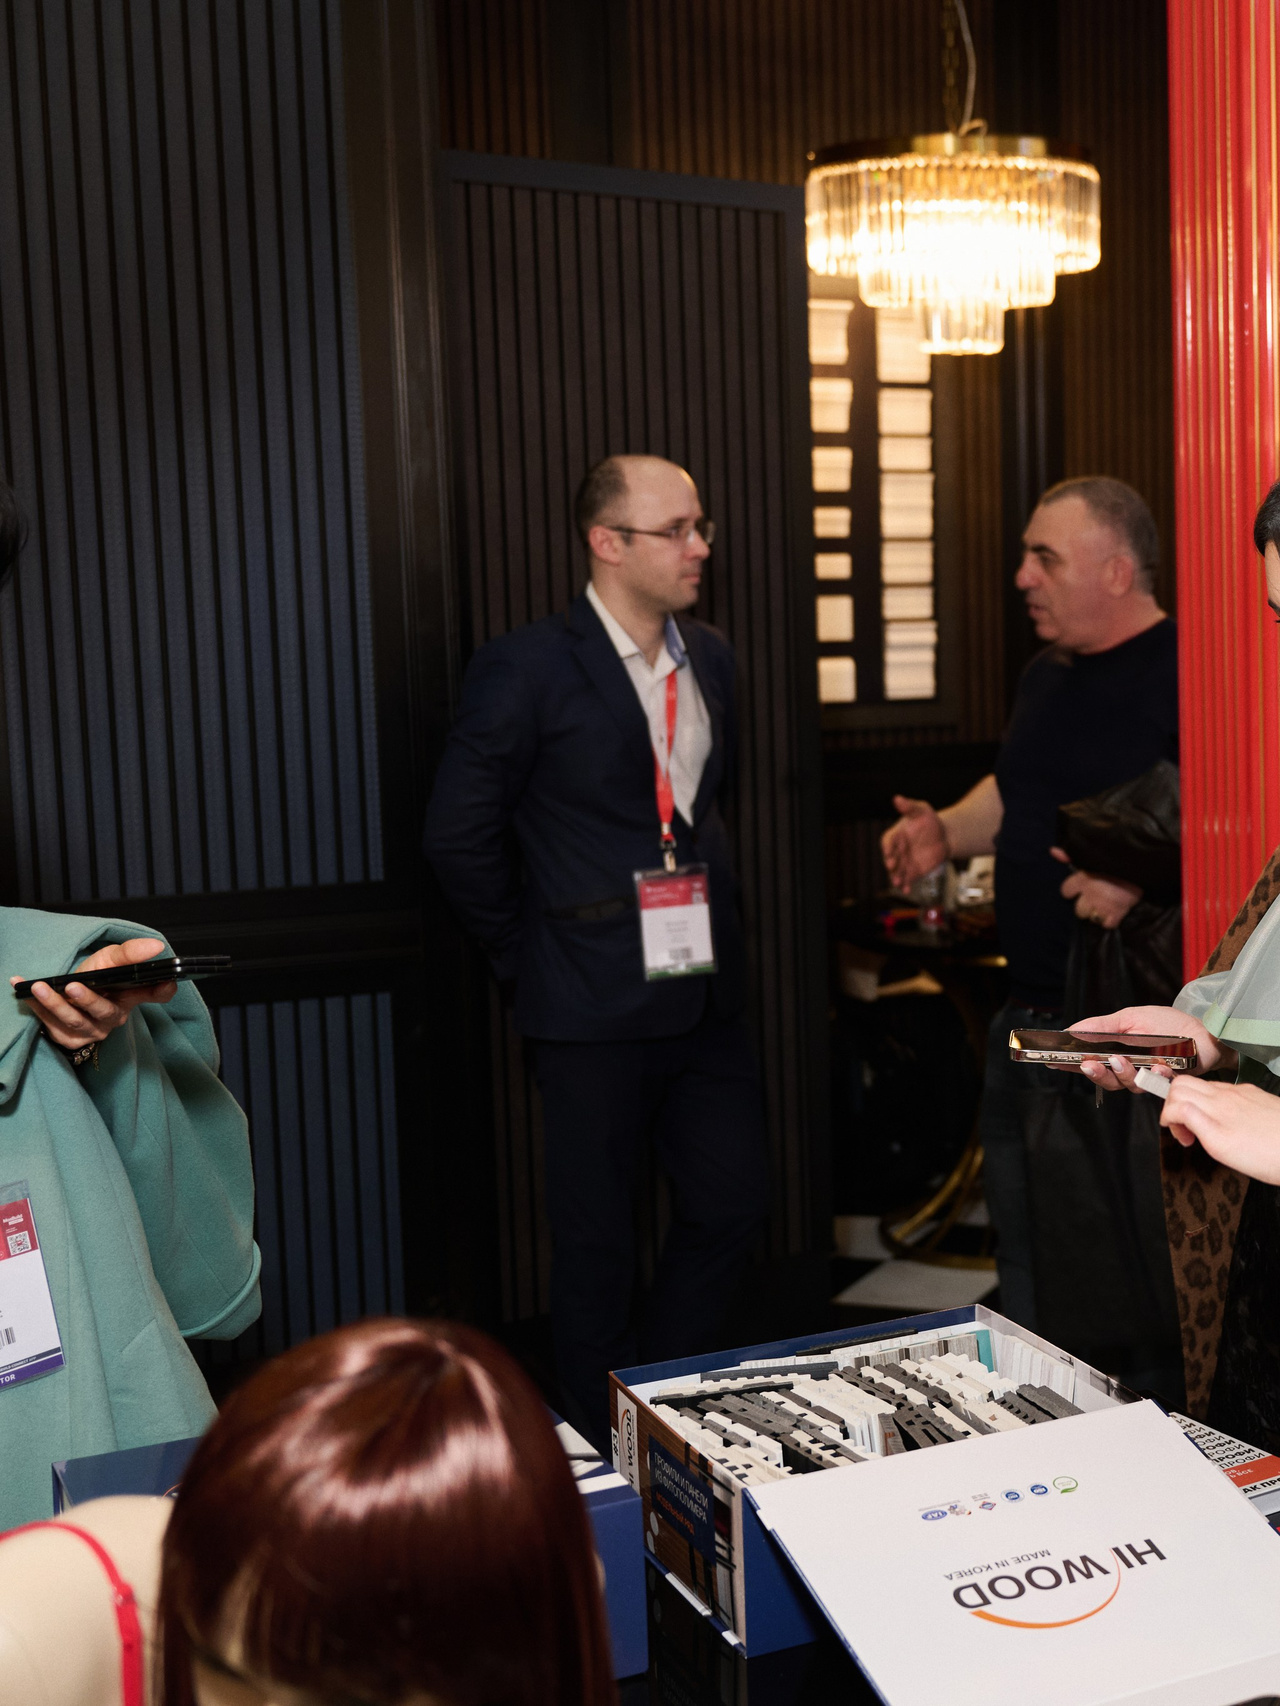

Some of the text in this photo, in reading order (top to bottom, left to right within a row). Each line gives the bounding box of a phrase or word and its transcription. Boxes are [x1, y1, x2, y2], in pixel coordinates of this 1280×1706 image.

[1192, 1431, 1216, 1440] ФИ
[1202, 1439, 1236, 1452] ОФИ
[1219, 1453, 1265, 1469] ПРОФИ
[654, 1452, 680, 1485] ПРОФИЛИ
[685, 1482, 709, 1510] ПАНЕЛИ
[662, 1476, 708, 1524] ФИТОПОЛИМЕРА
[943, 1549, 1052, 1581] MADE IN KOREA
[952, 1539, 1167, 1609] HI WOOD
